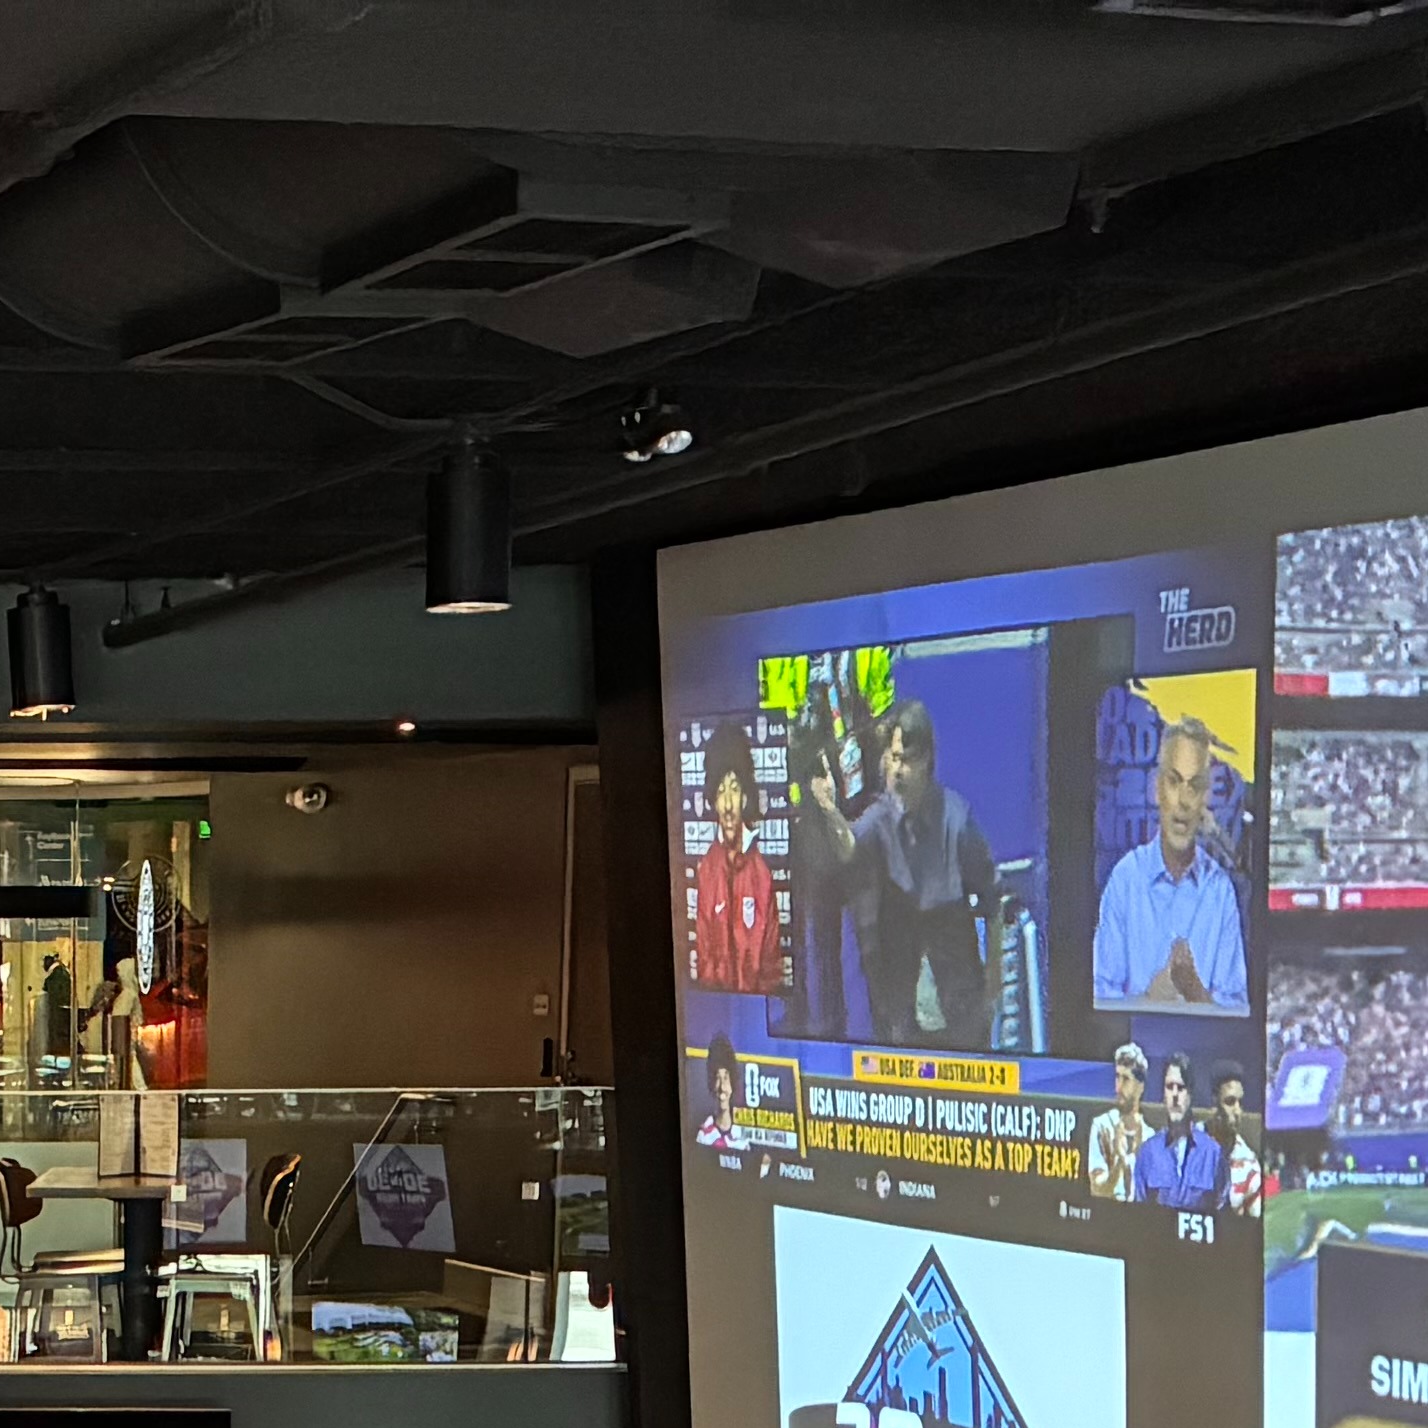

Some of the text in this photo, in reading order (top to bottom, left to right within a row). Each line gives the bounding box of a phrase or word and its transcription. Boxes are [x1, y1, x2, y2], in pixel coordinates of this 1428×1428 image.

[1159, 587, 1190, 613] THE
[1167, 611, 1233, 649] HERD
[760, 1075, 780, 1098] FOX
[878, 1057, 897, 1077] USA
[936, 1061, 987, 1084] AUSTRALIA
[809, 1086, 834, 1118] USA
[835, 1088, 868, 1122] WINS
[869, 1091, 912, 1126] GROUP
[936, 1099, 987, 1134] PULISIC
[990, 1103, 1042, 1139] (CALF):
[1044, 1107, 1076, 1142] DNP
[807, 1117, 834, 1150] HAVE
[835, 1120, 854, 1152] WE
[855, 1122, 901, 1158] PROVEN
[903, 1128, 972, 1169] OURSELVES
[974, 1136, 993, 1169] AS
[994, 1138, 1006, 1171] A
[1007, 1140, 1034, 1173] TOP
[1036, 1143, 1081, 1180] TEAM?
[778, 1161, 815, 1182] PHOENIX
[898, 1180, 937, 1201] INDIANA
[1177, 1211, 1215, 1244] FS1
